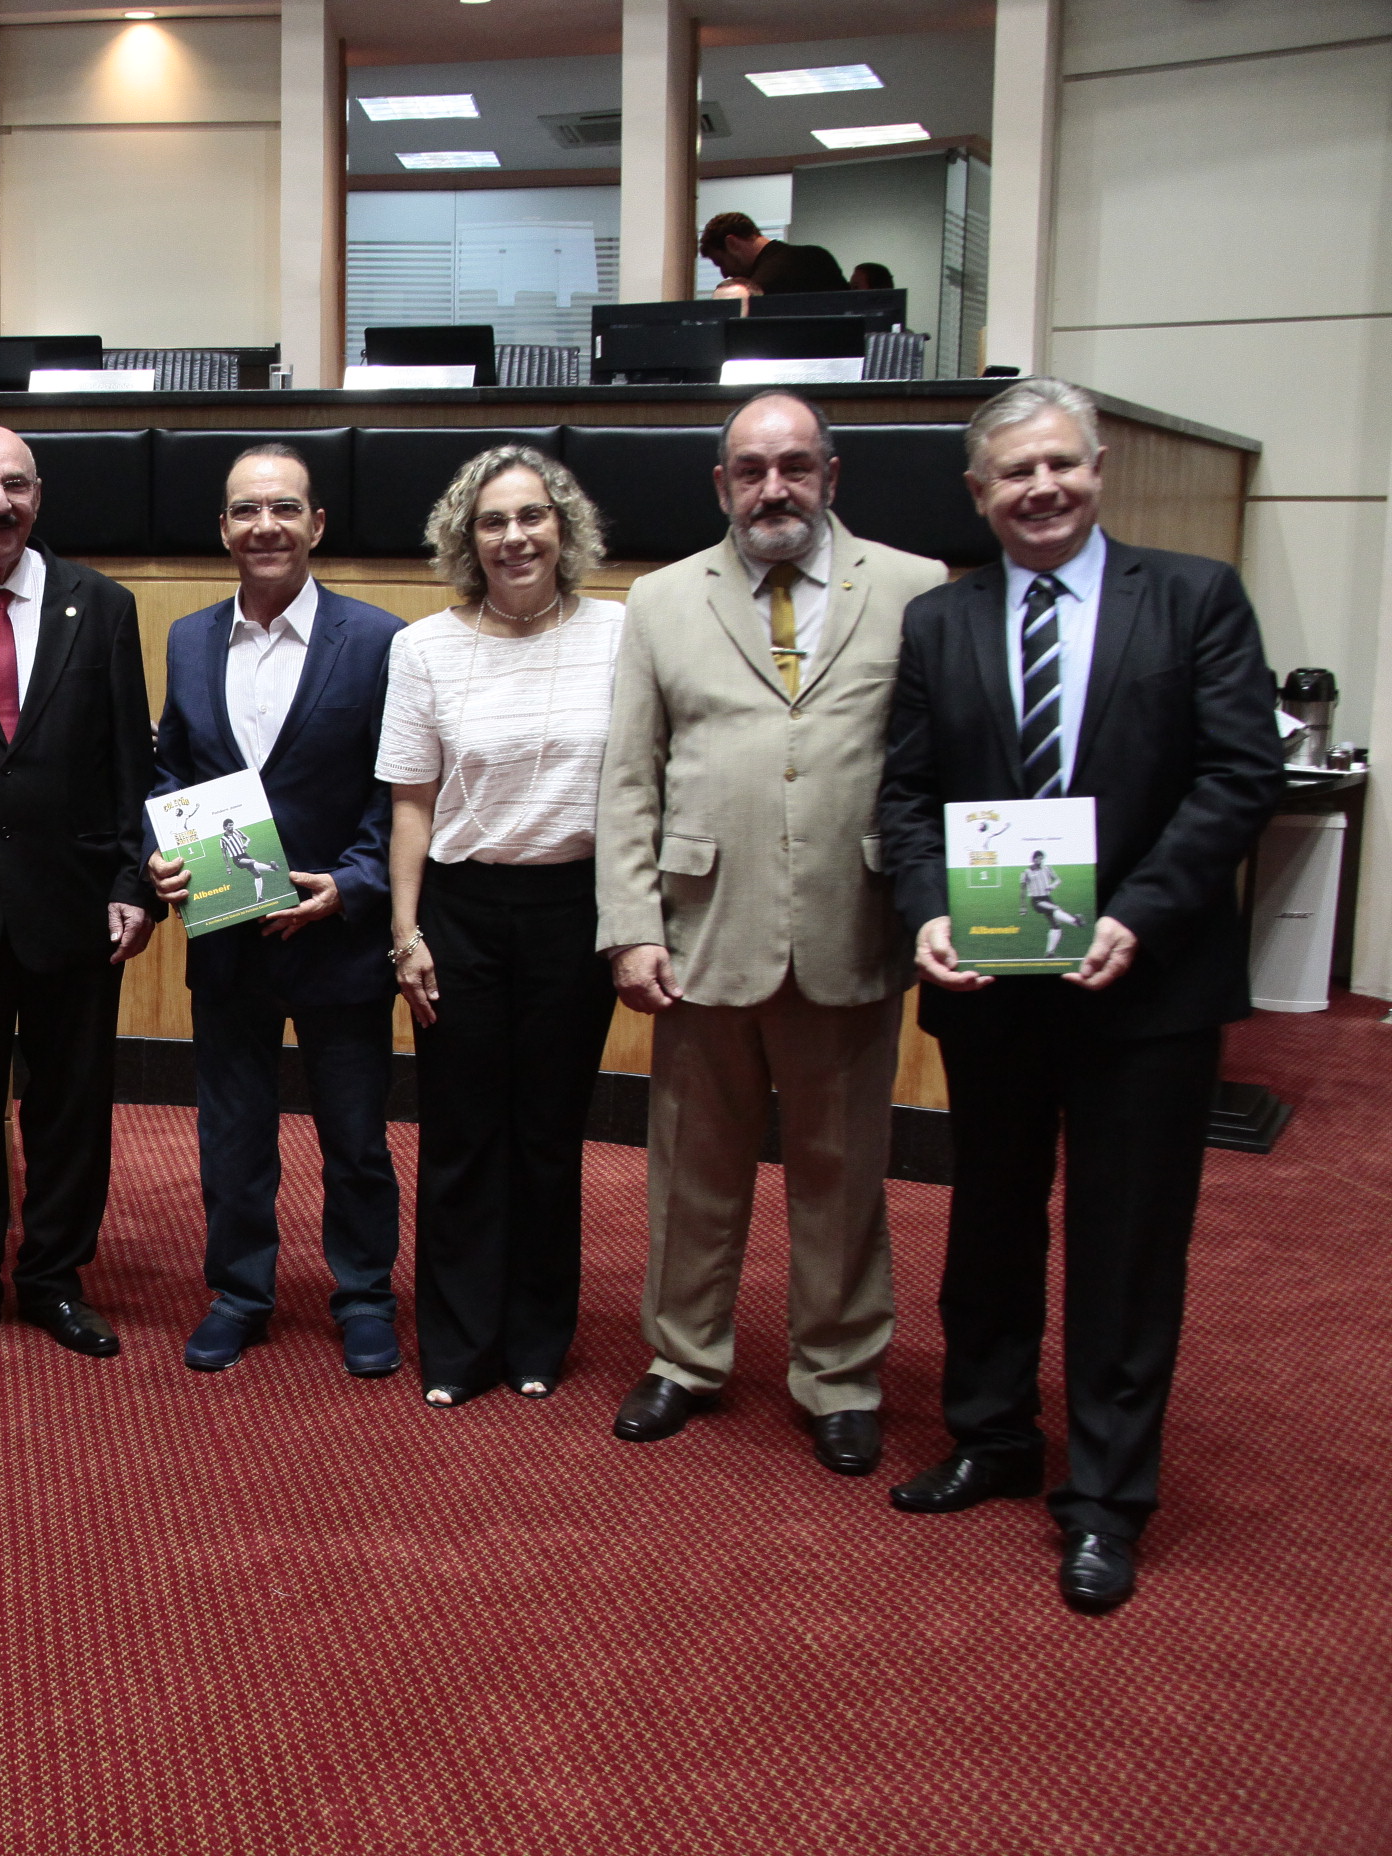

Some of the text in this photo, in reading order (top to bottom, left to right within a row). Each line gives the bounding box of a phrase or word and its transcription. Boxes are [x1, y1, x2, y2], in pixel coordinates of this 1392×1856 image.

[188, 847, 195, 855] 1
[979, 870, 988, 880] 1
[193, 884, 231, 901] Albeneir
